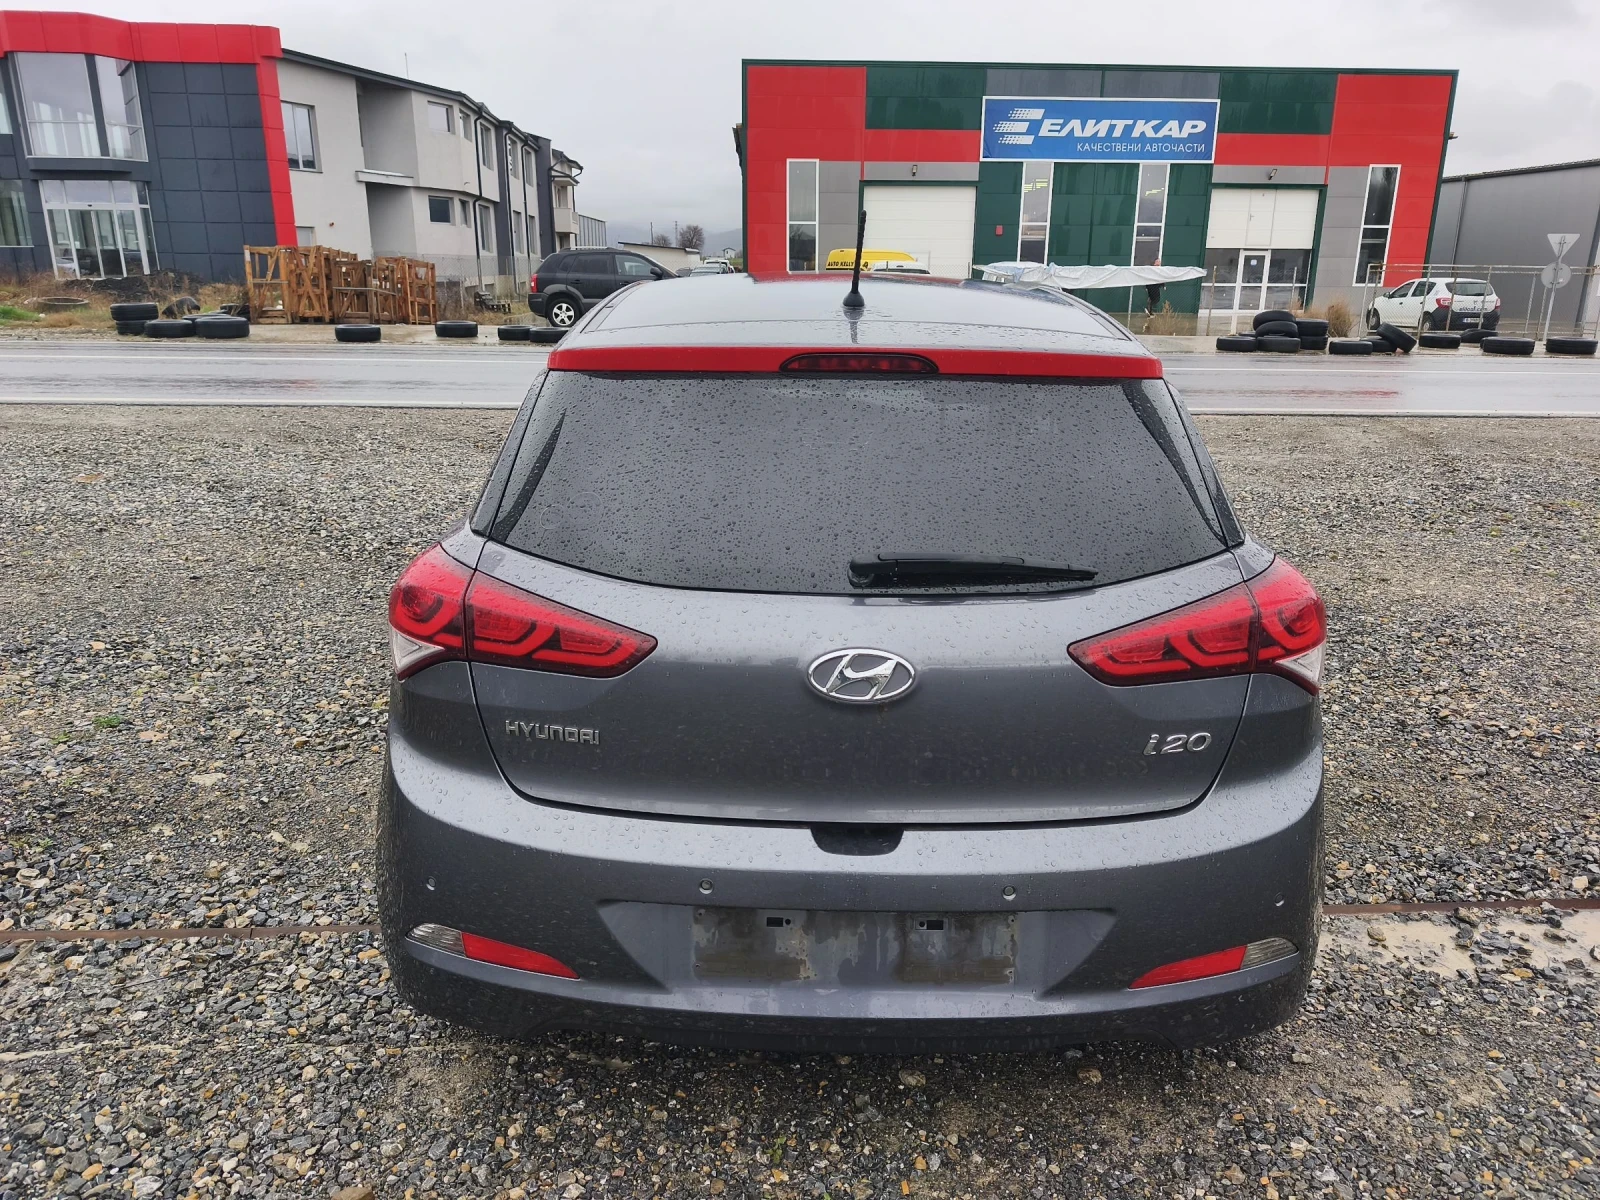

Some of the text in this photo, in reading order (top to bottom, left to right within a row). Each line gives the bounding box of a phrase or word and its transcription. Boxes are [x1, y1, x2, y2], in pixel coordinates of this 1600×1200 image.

[1038, 118, 1207, 138] ЕЛИТ КАР
[1076, 142, 1206, 153] КАЧЕСТВЕНИ АВТОЧАСТИ
[505, 720, 600, 745] HYUNDAI
[1143, 732, 1212, 756] i20
